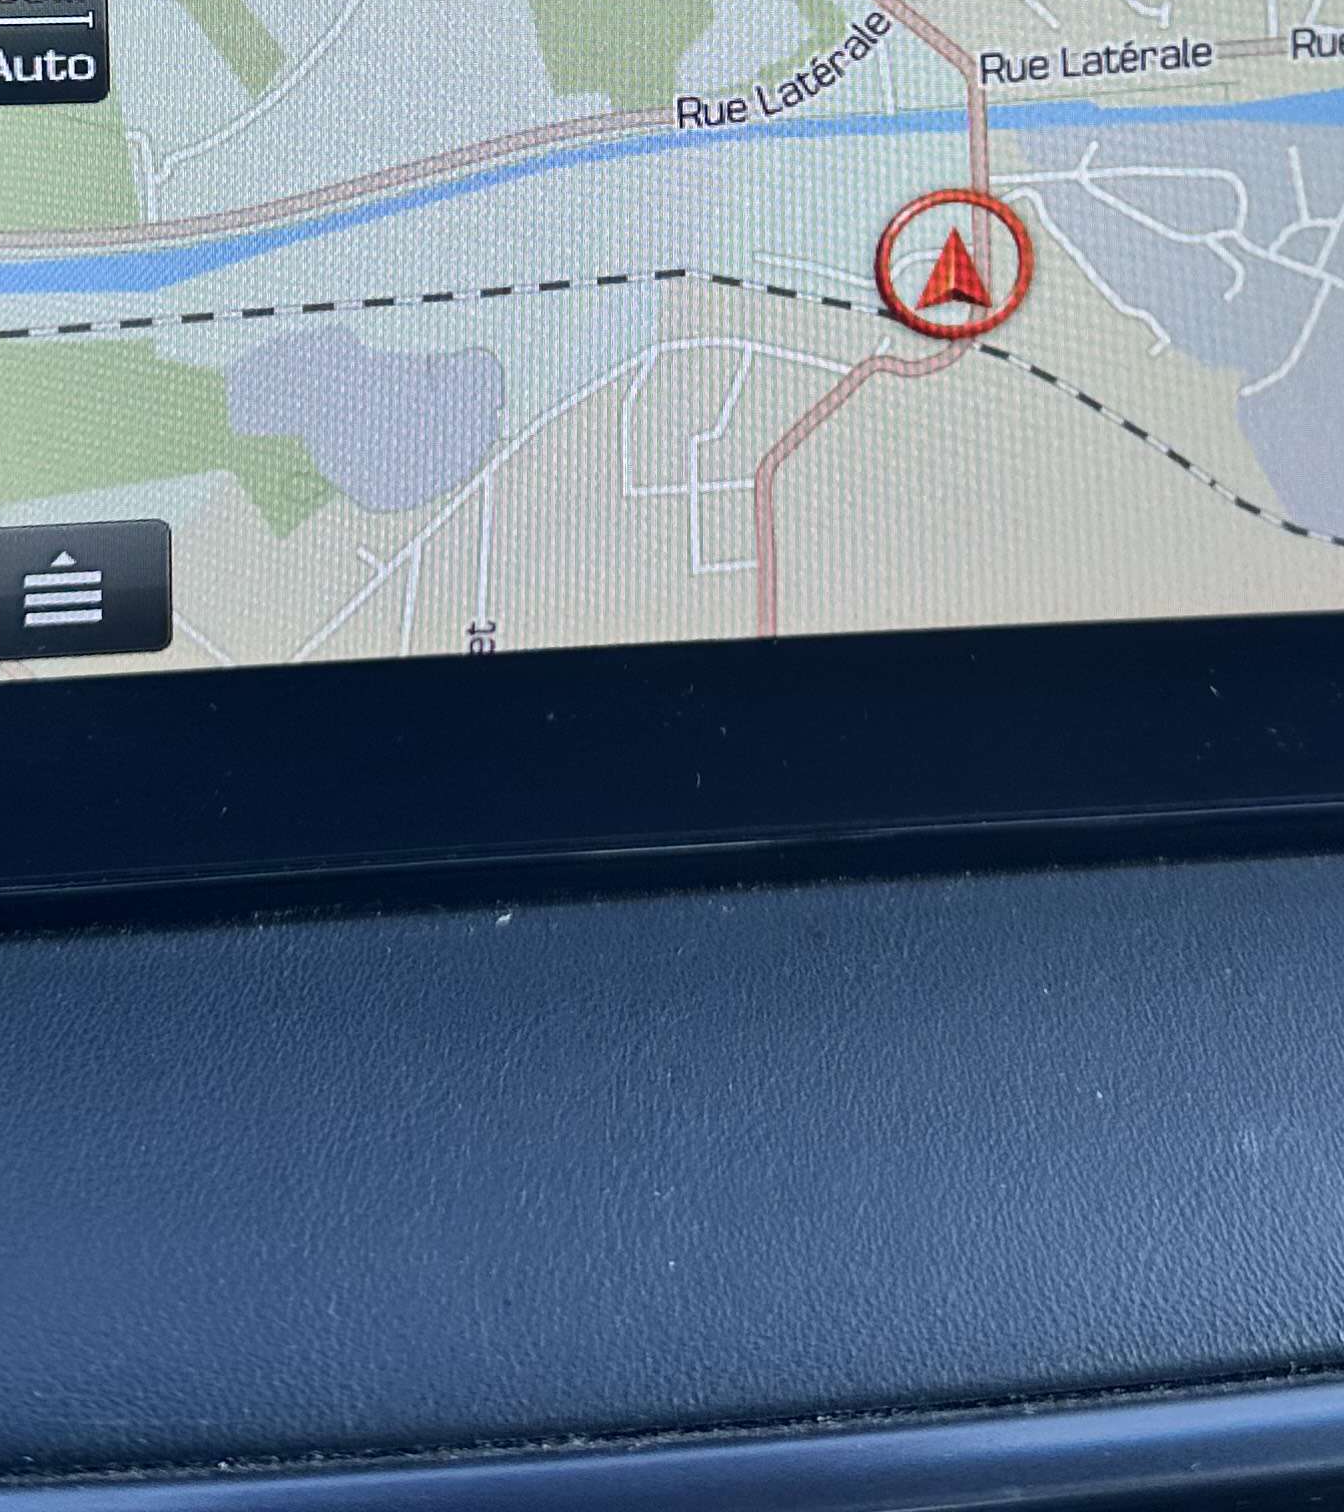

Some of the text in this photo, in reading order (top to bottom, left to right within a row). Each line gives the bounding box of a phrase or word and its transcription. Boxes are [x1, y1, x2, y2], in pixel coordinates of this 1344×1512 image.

[676, 11, 893, 130] Rue Latérale
[979, 37, 1213, 85] Rue Latérale
